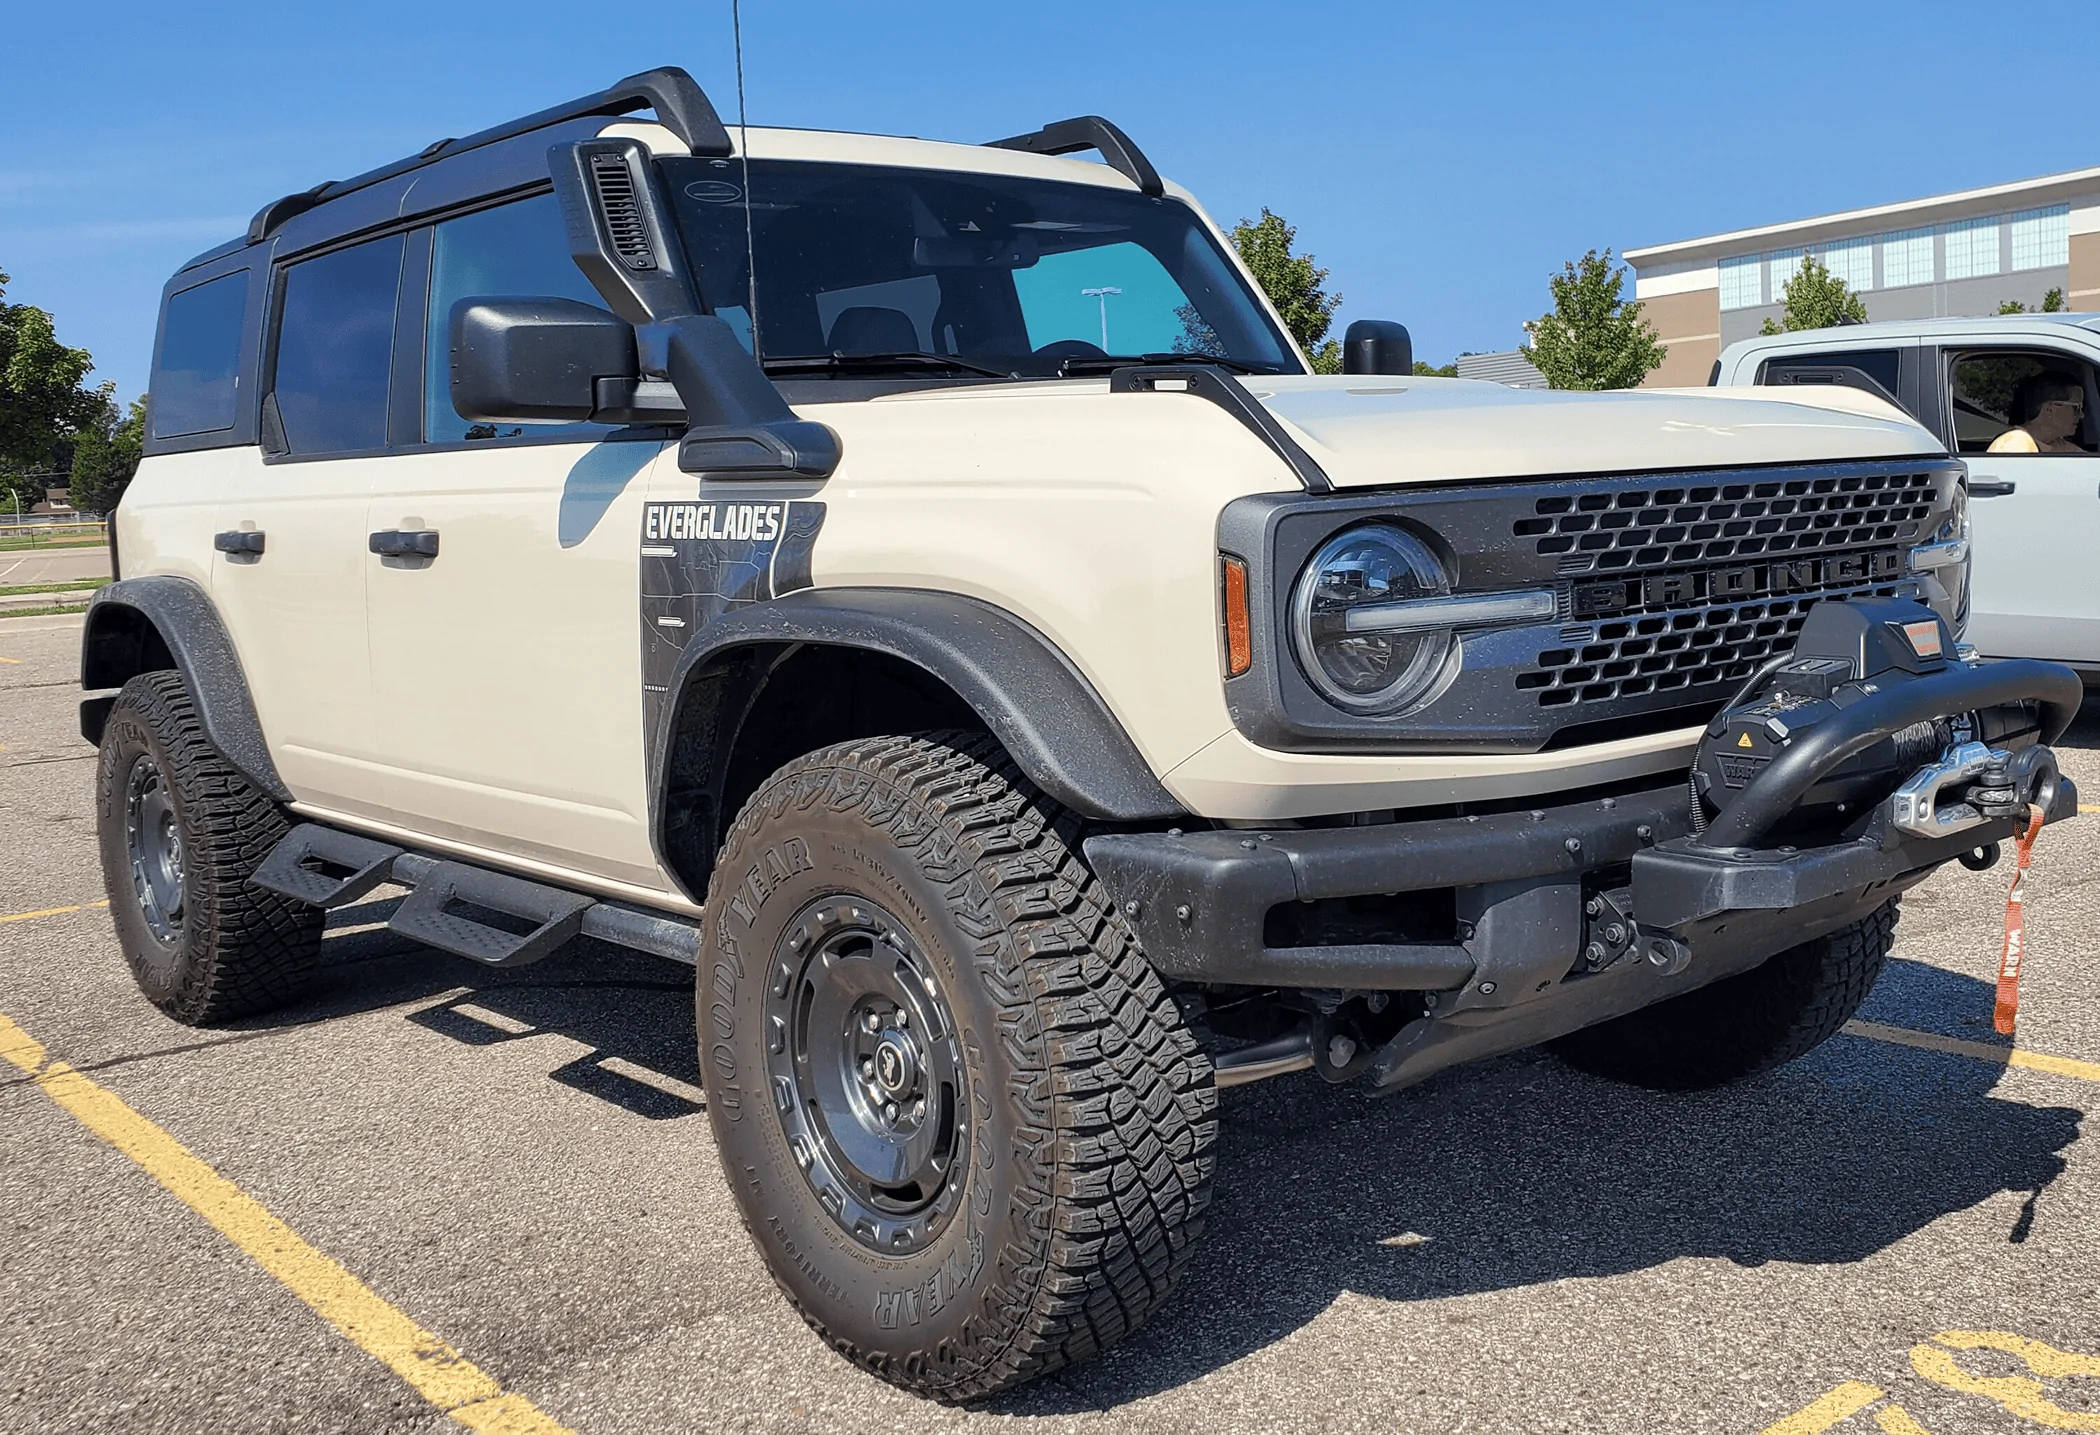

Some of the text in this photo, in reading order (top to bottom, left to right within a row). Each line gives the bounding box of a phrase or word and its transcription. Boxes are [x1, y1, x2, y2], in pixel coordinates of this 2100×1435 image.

[646, 505, 781, 541] EVERGLADES
[1571, 551, 1906, 614] BRONCO
[1724, 763, 1758, 780] WAR
[712, 837, 815, 1123] GOODYEAR
[2002, 929, 2022, 978] WARN
[874, 1028, 995, 1331] GOODYEAR
[767, 1216, 848, 1303] TERRITORY
